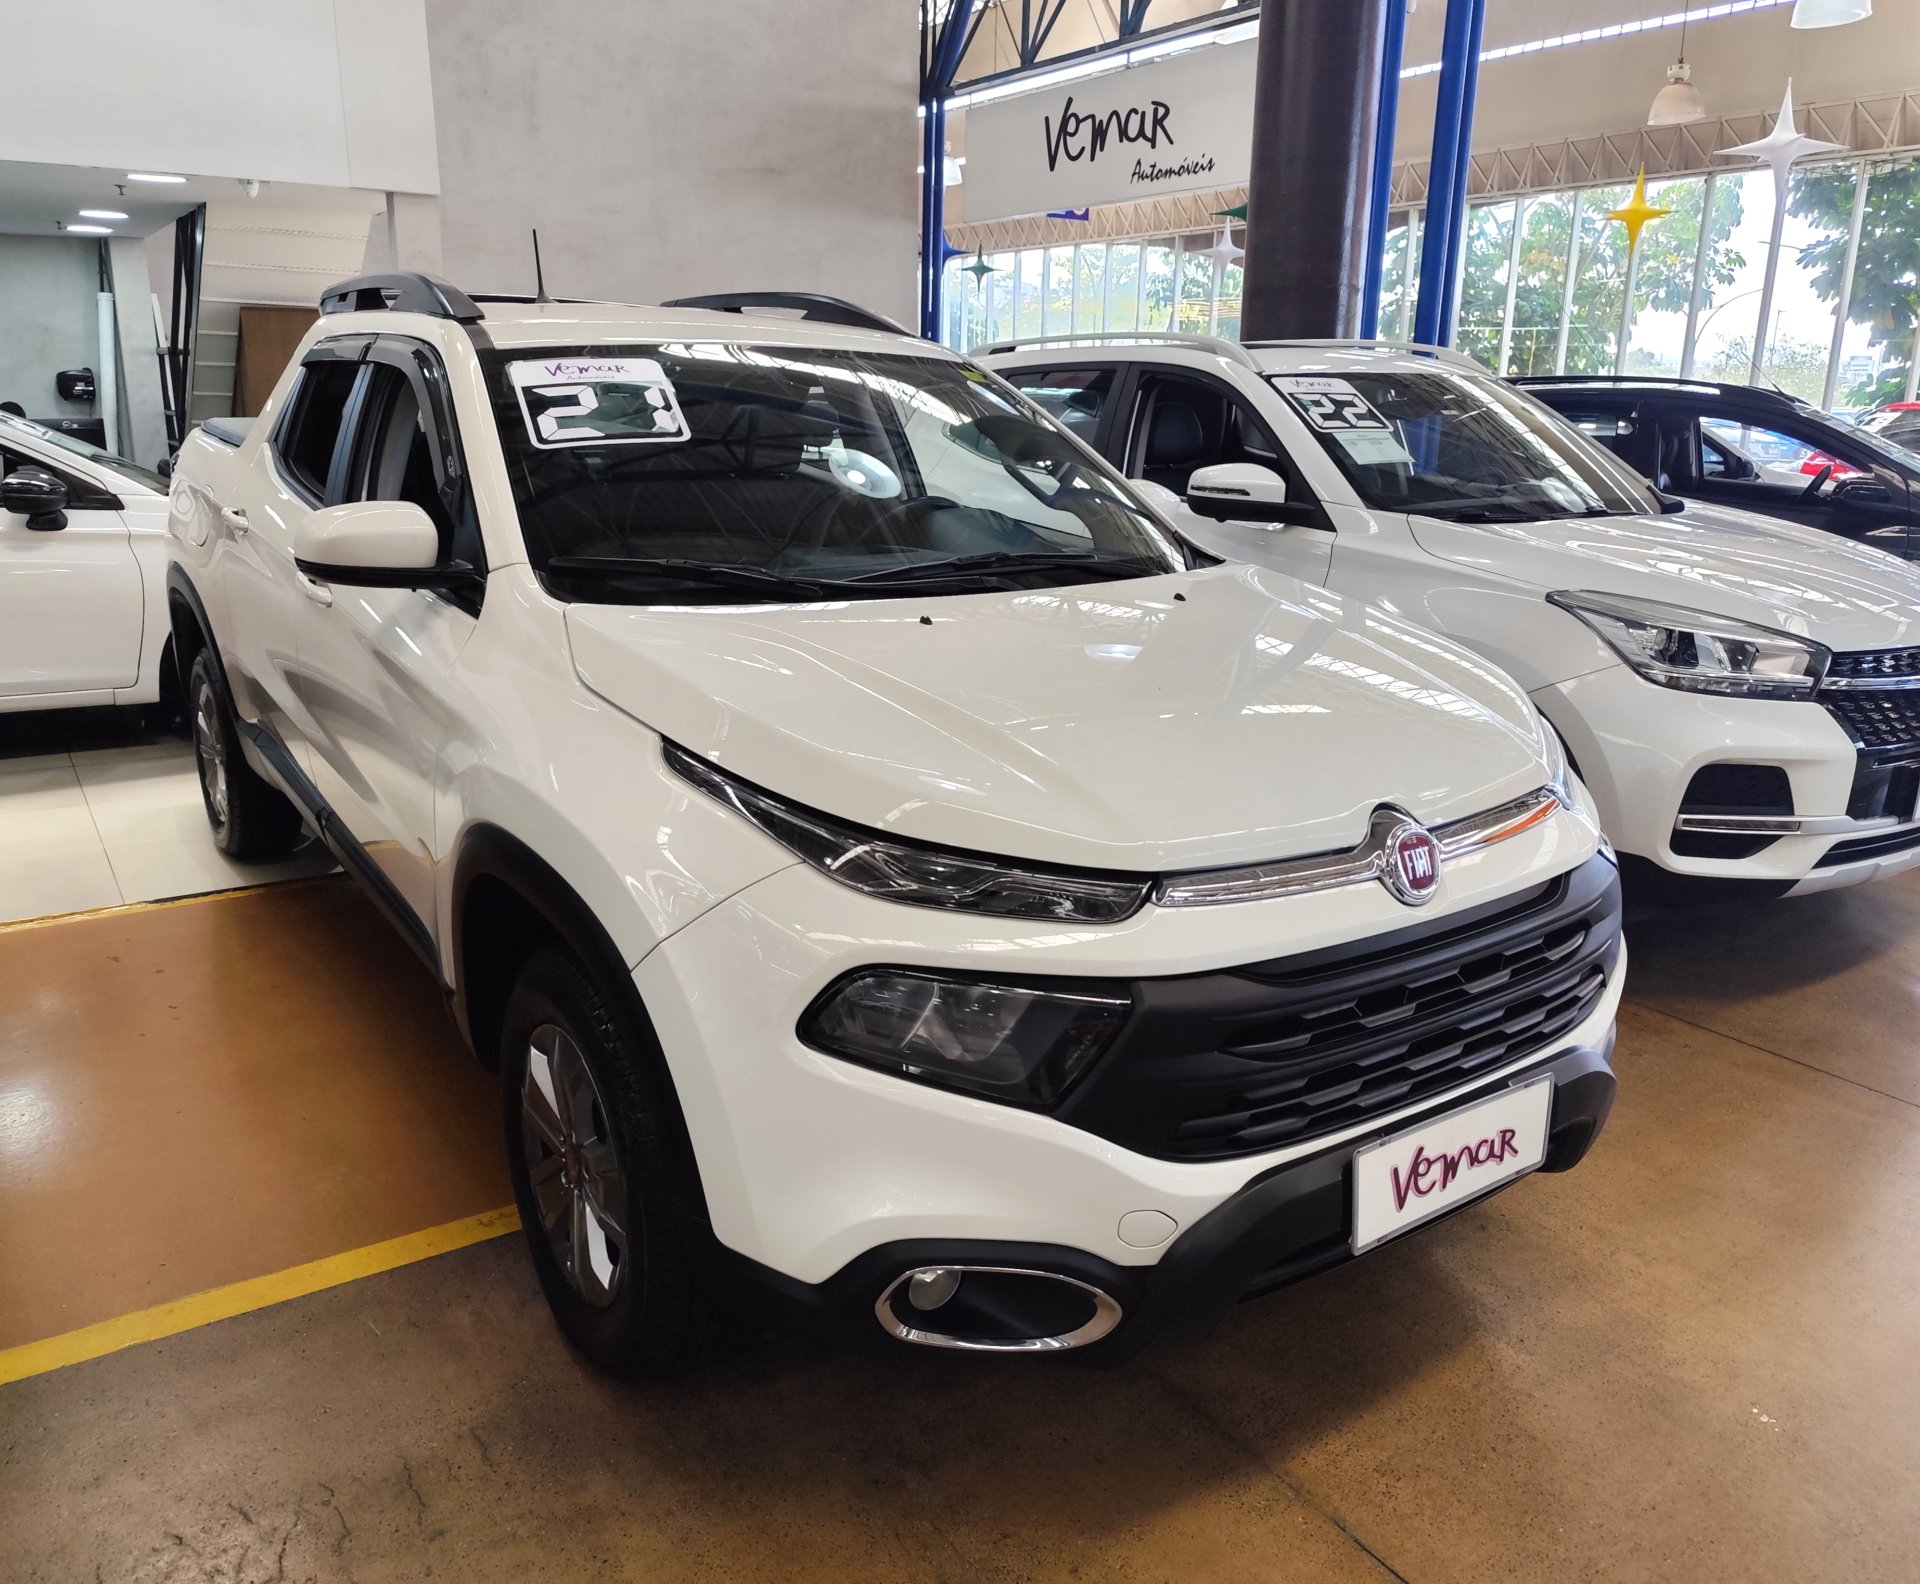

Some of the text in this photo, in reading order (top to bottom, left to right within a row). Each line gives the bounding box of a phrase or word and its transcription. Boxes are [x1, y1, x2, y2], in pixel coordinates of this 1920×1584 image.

[1130, 153, 1216, 184] Automóveis
[1293, 393, 1385, 428] 22
[1403, 846, 1433, 881] FIAT
